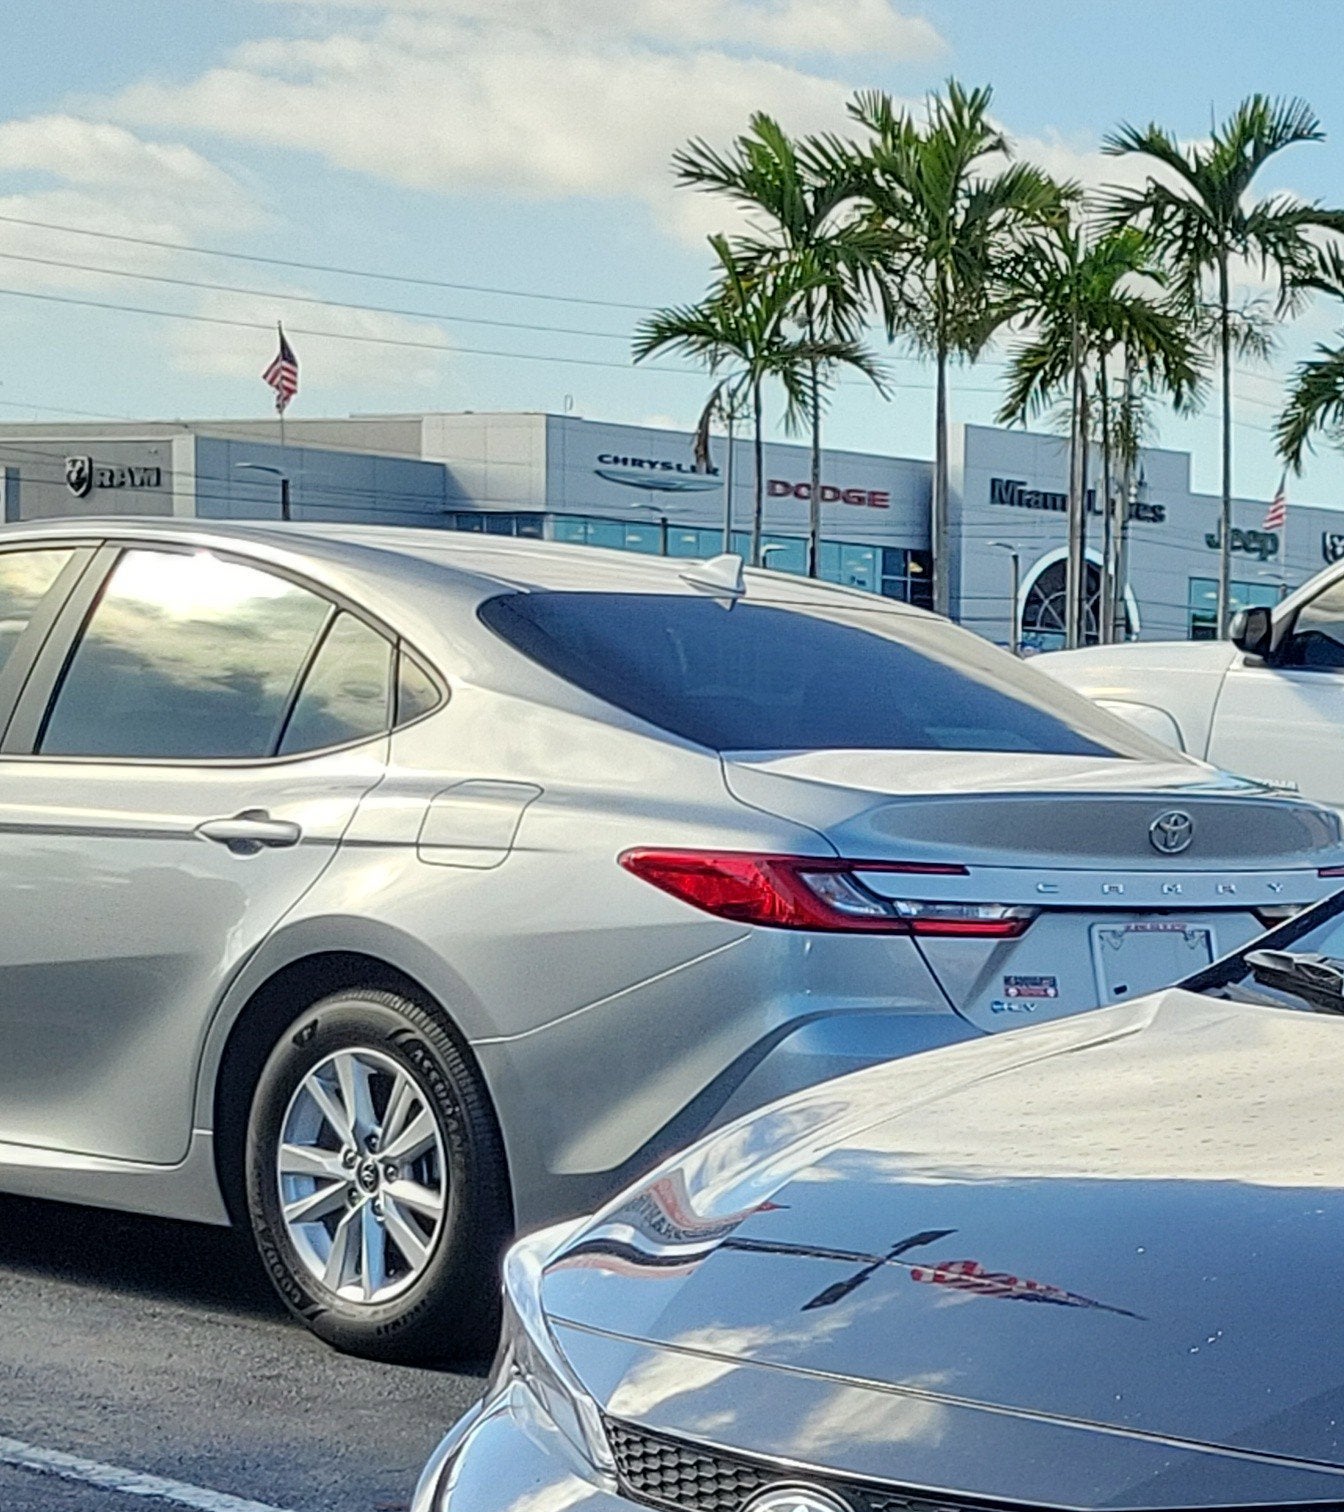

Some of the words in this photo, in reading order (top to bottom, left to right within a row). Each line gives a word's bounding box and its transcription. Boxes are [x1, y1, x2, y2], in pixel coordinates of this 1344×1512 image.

[96, 466, 162, 489] RAM
[767, 479, 891, 509] DODGE
[990, 477, 1069, 512] Miam
[1086, 489, 1167, 523] Les
[1205, 518, 1280, 561] Jeep
[1036, 882, 1285, 896] CAMRY
